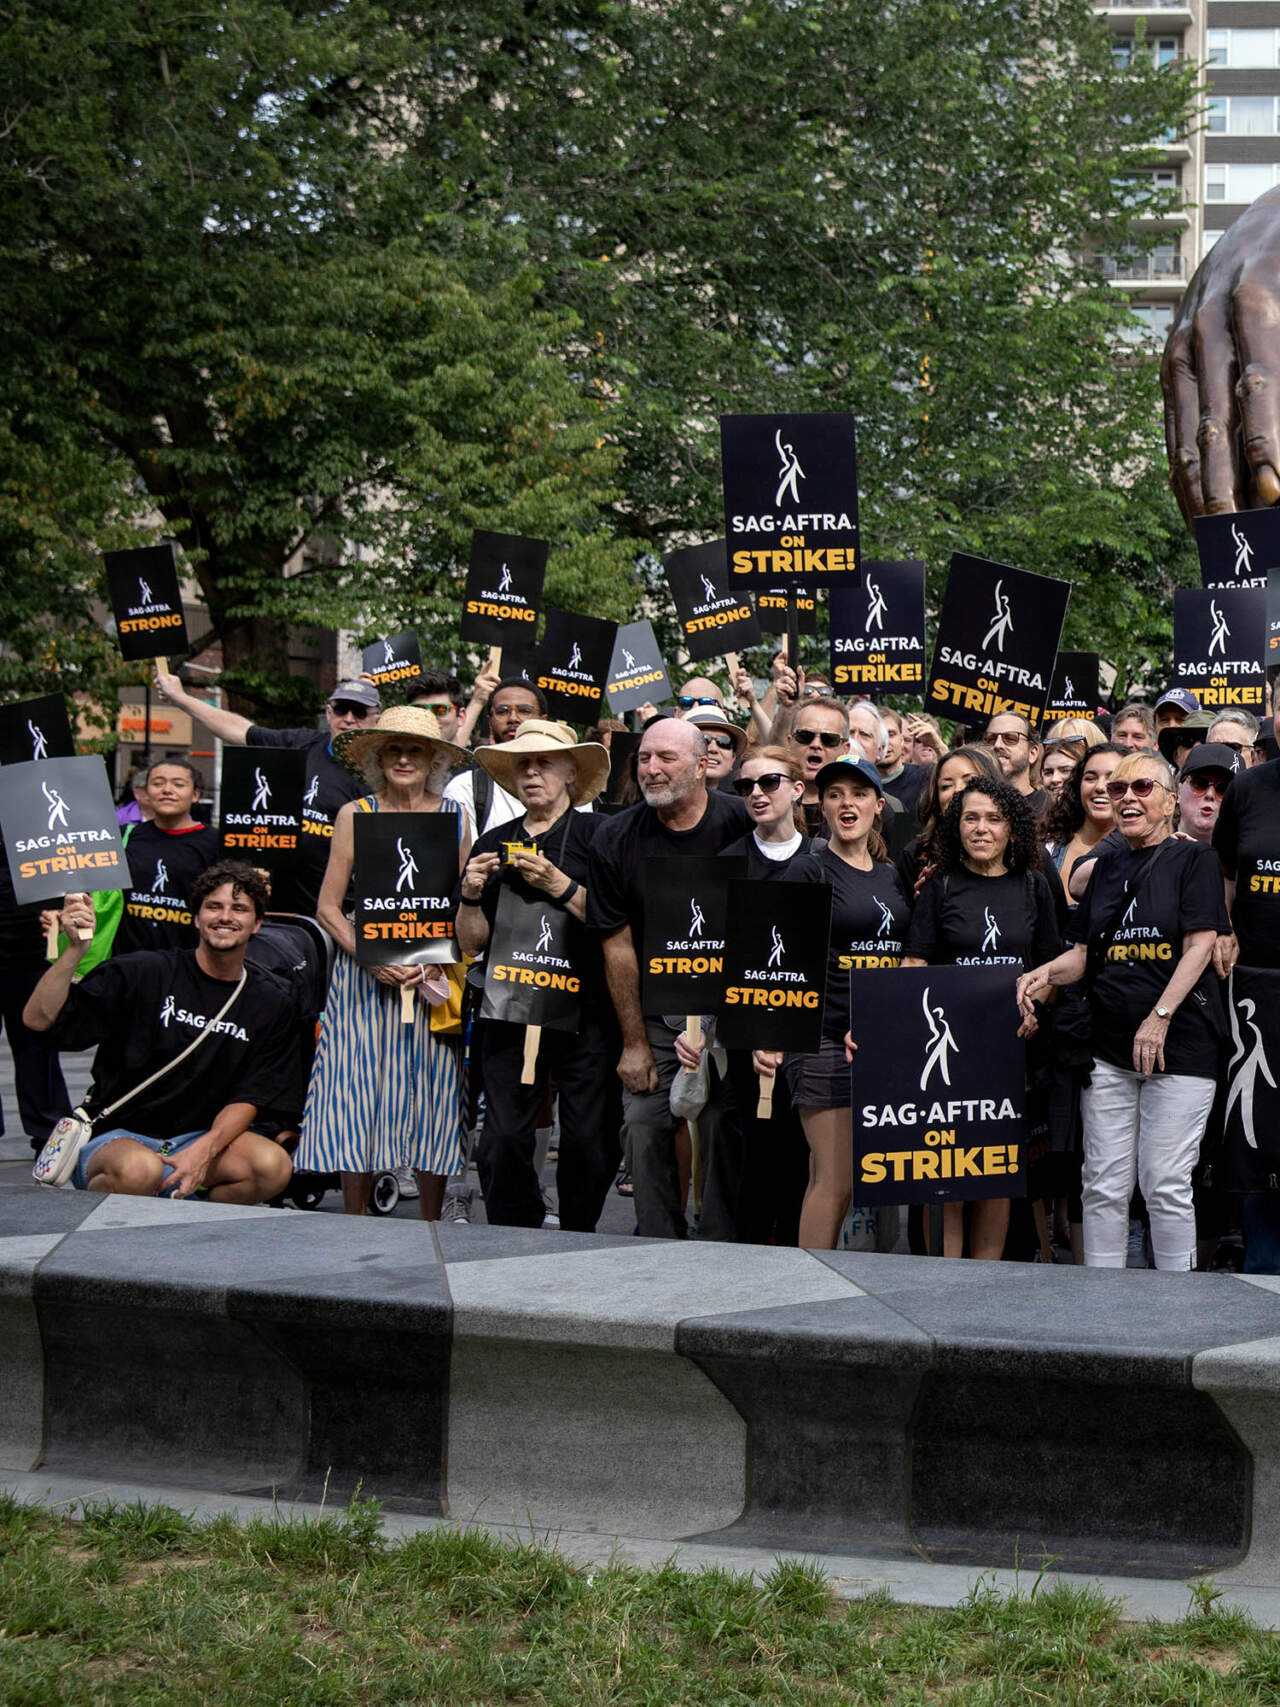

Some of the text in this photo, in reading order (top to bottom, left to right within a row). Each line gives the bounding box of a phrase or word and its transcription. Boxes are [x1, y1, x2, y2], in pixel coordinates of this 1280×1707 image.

[780, 536, 805, 548] ON
[733, 548, 855, 573] STRIKE!
[467, 601, 535, 622] STRONG
[759, 596, 814, 610] STRNG
[120, 614, 182, 632] STRONG
[685, 606, 751, 633] STRONG
[868, 654, 886, 663] ON
[608, 670, 664, 693] STRONG
[835, 664, 922, 682] STRIKE!
[537, 677, 600, 699] STRONG
[977, 678, 999, 692] ON
[1210, 677, 1228, 687] ON
[932, 678, 1040, 728] STRIKE!
[1187, 687, 1262, 705] TRIKE!
[1043, 710, 1094, 720] STRONG
[302, 820, 336, 837] ONG
[224, 834, 297, 849] STRIKE!
[56, 846, 77, 855] ON
[19, 851, 119, 878] STRIKE!
[399, 912, 417, 921] ON
[363, 922, 453, 939] STRIKE!
[1113, 927, 1163, 940] G·AFTRA
[851, 940, 901, 951] SAG·AFTR
[1108, 944, 1171, 960] RONG
[650, 957, 723, 974] STRON
[839, 956, 900, 969] STRON
[493, 966, 579, 992] STRONG
[725, 987, 818, 1008] STRONG
[925, 1130, 955, 1146] ON
[861, 1145, 1018, 1183] STRIKE!
